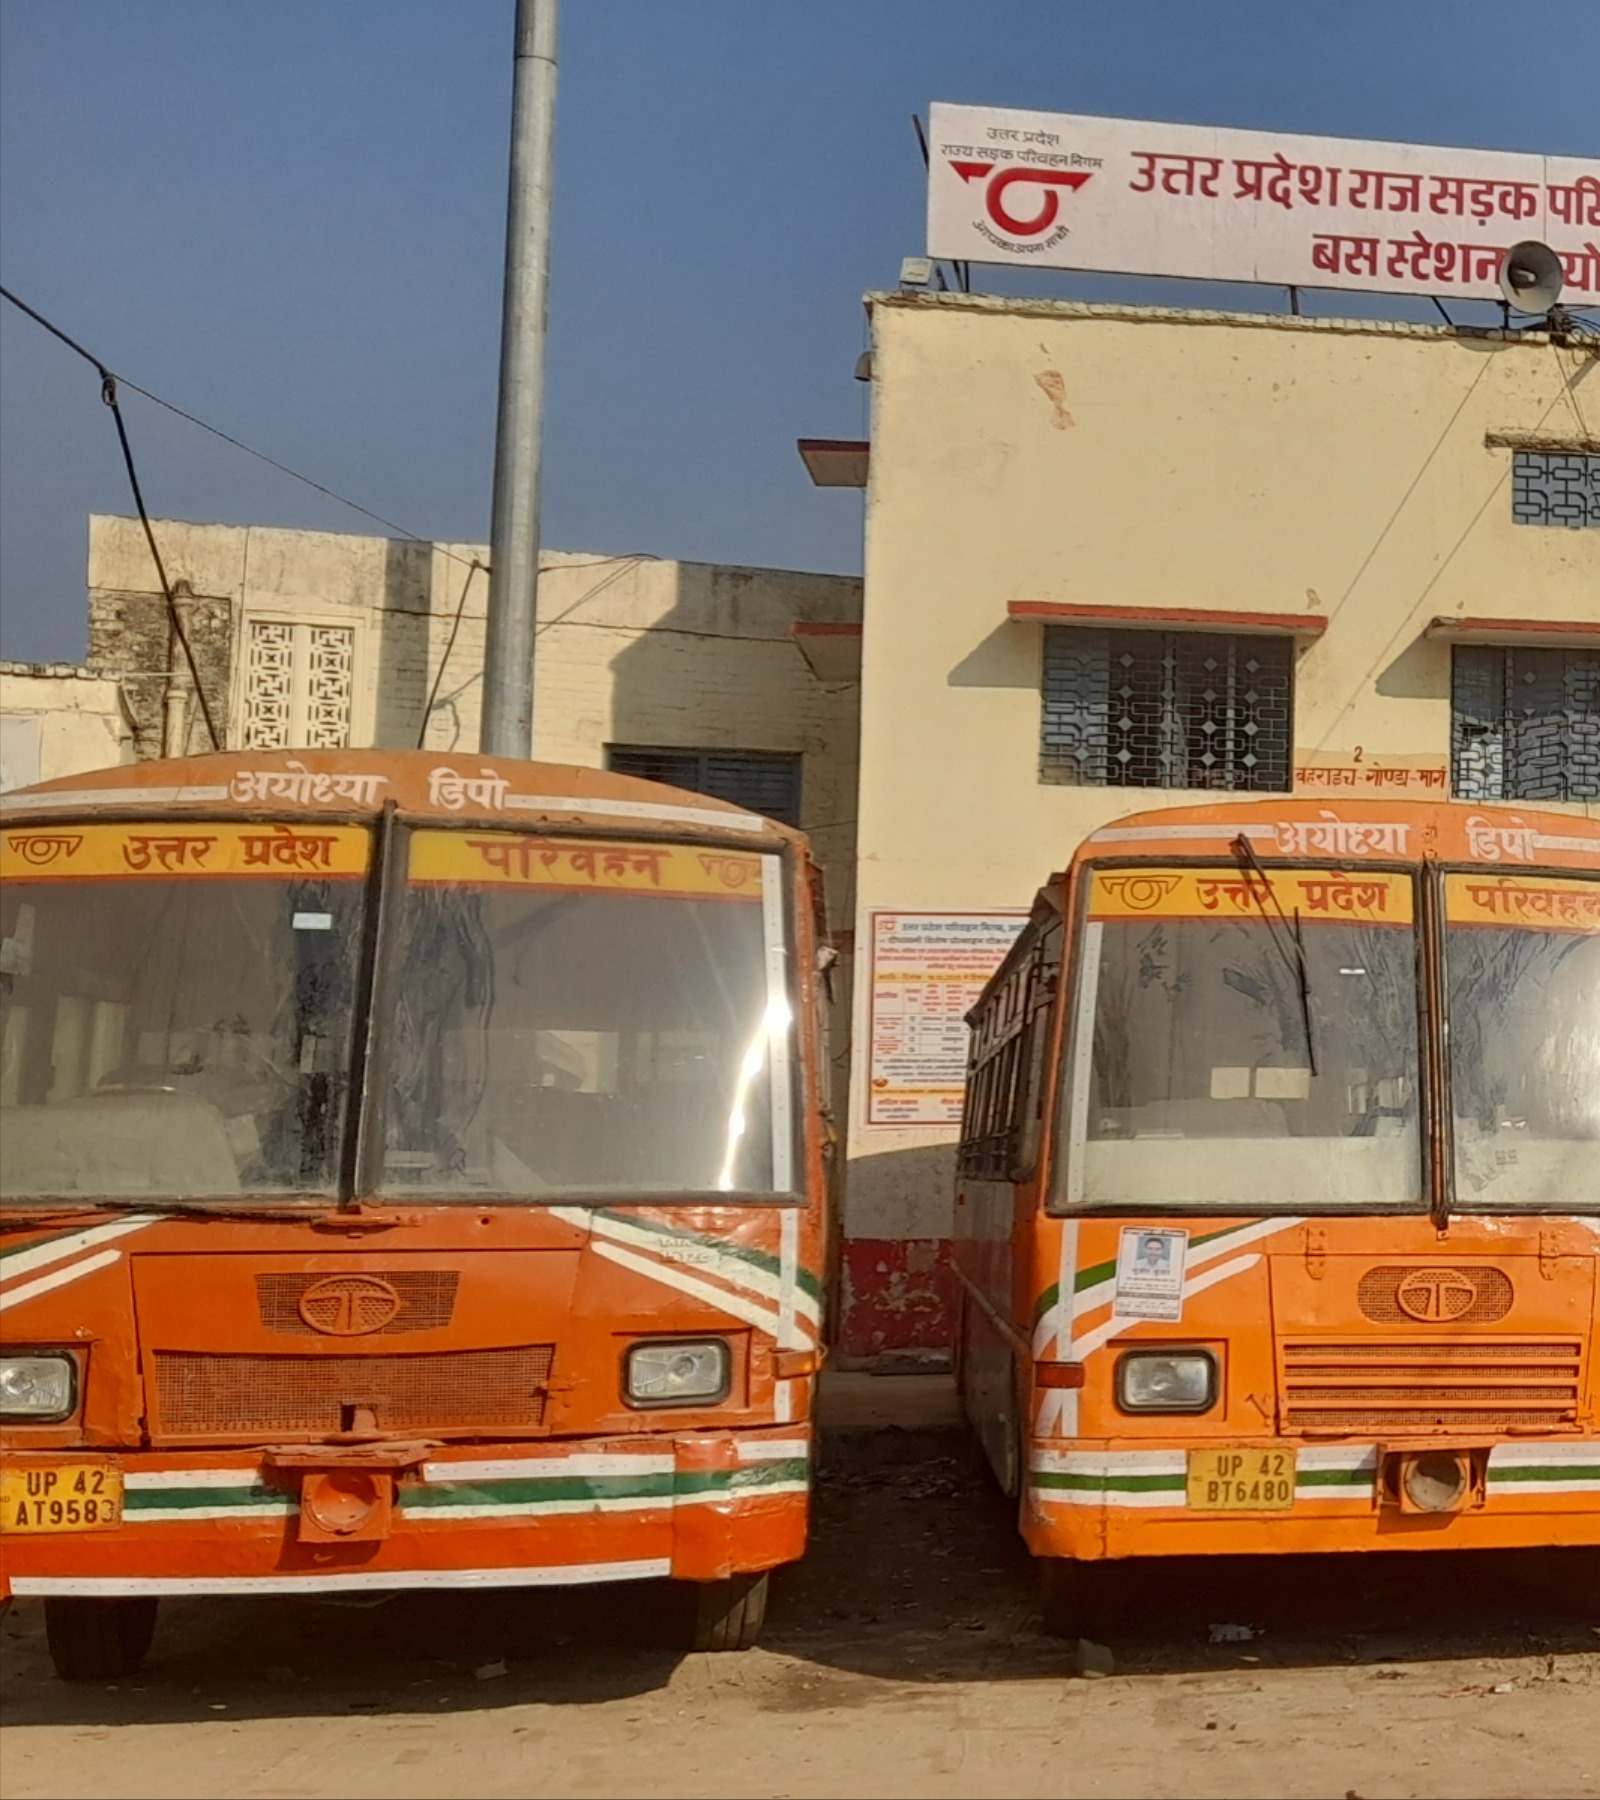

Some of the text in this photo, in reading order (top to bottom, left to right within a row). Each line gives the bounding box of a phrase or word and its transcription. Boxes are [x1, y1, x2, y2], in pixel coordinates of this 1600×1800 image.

[1022, 130, 1060, 146] प्रदेश
[1017, 149, 1068, 167] परिवहन
[1069, 152, 1103, 168] निगम
[1129, 151, 1224, 198] उत्तर
[1231, 152, 1342, 210] प्रदेश
[1348, 169, 1424, 213] राज
[1429, 175, 1539, 226] सड़क
[1312, 233, 1380, 277] बस
[1386, 230, 1507, 285] स्टेशन
[1353, 745, 1363, 763] 2
[230, 760, 513, 810] अयोध्या डिपो
[1274, 810, 1538, 862] अयोध्या डिपो
[122, 826, 673, 886] उत्तर प्रदेश परिवहन
[1195, 877, 1274, 912] उत्तर
[1297, 872, 1389, 919] प्रदेश
[1217, 1455, 1285, 1477] UP 42
[27, 1470, 105, 1496] UP 42
[1207, 1480, 1289, 1503] BT6480
[15, 1499, 115, 1526] AT9583
